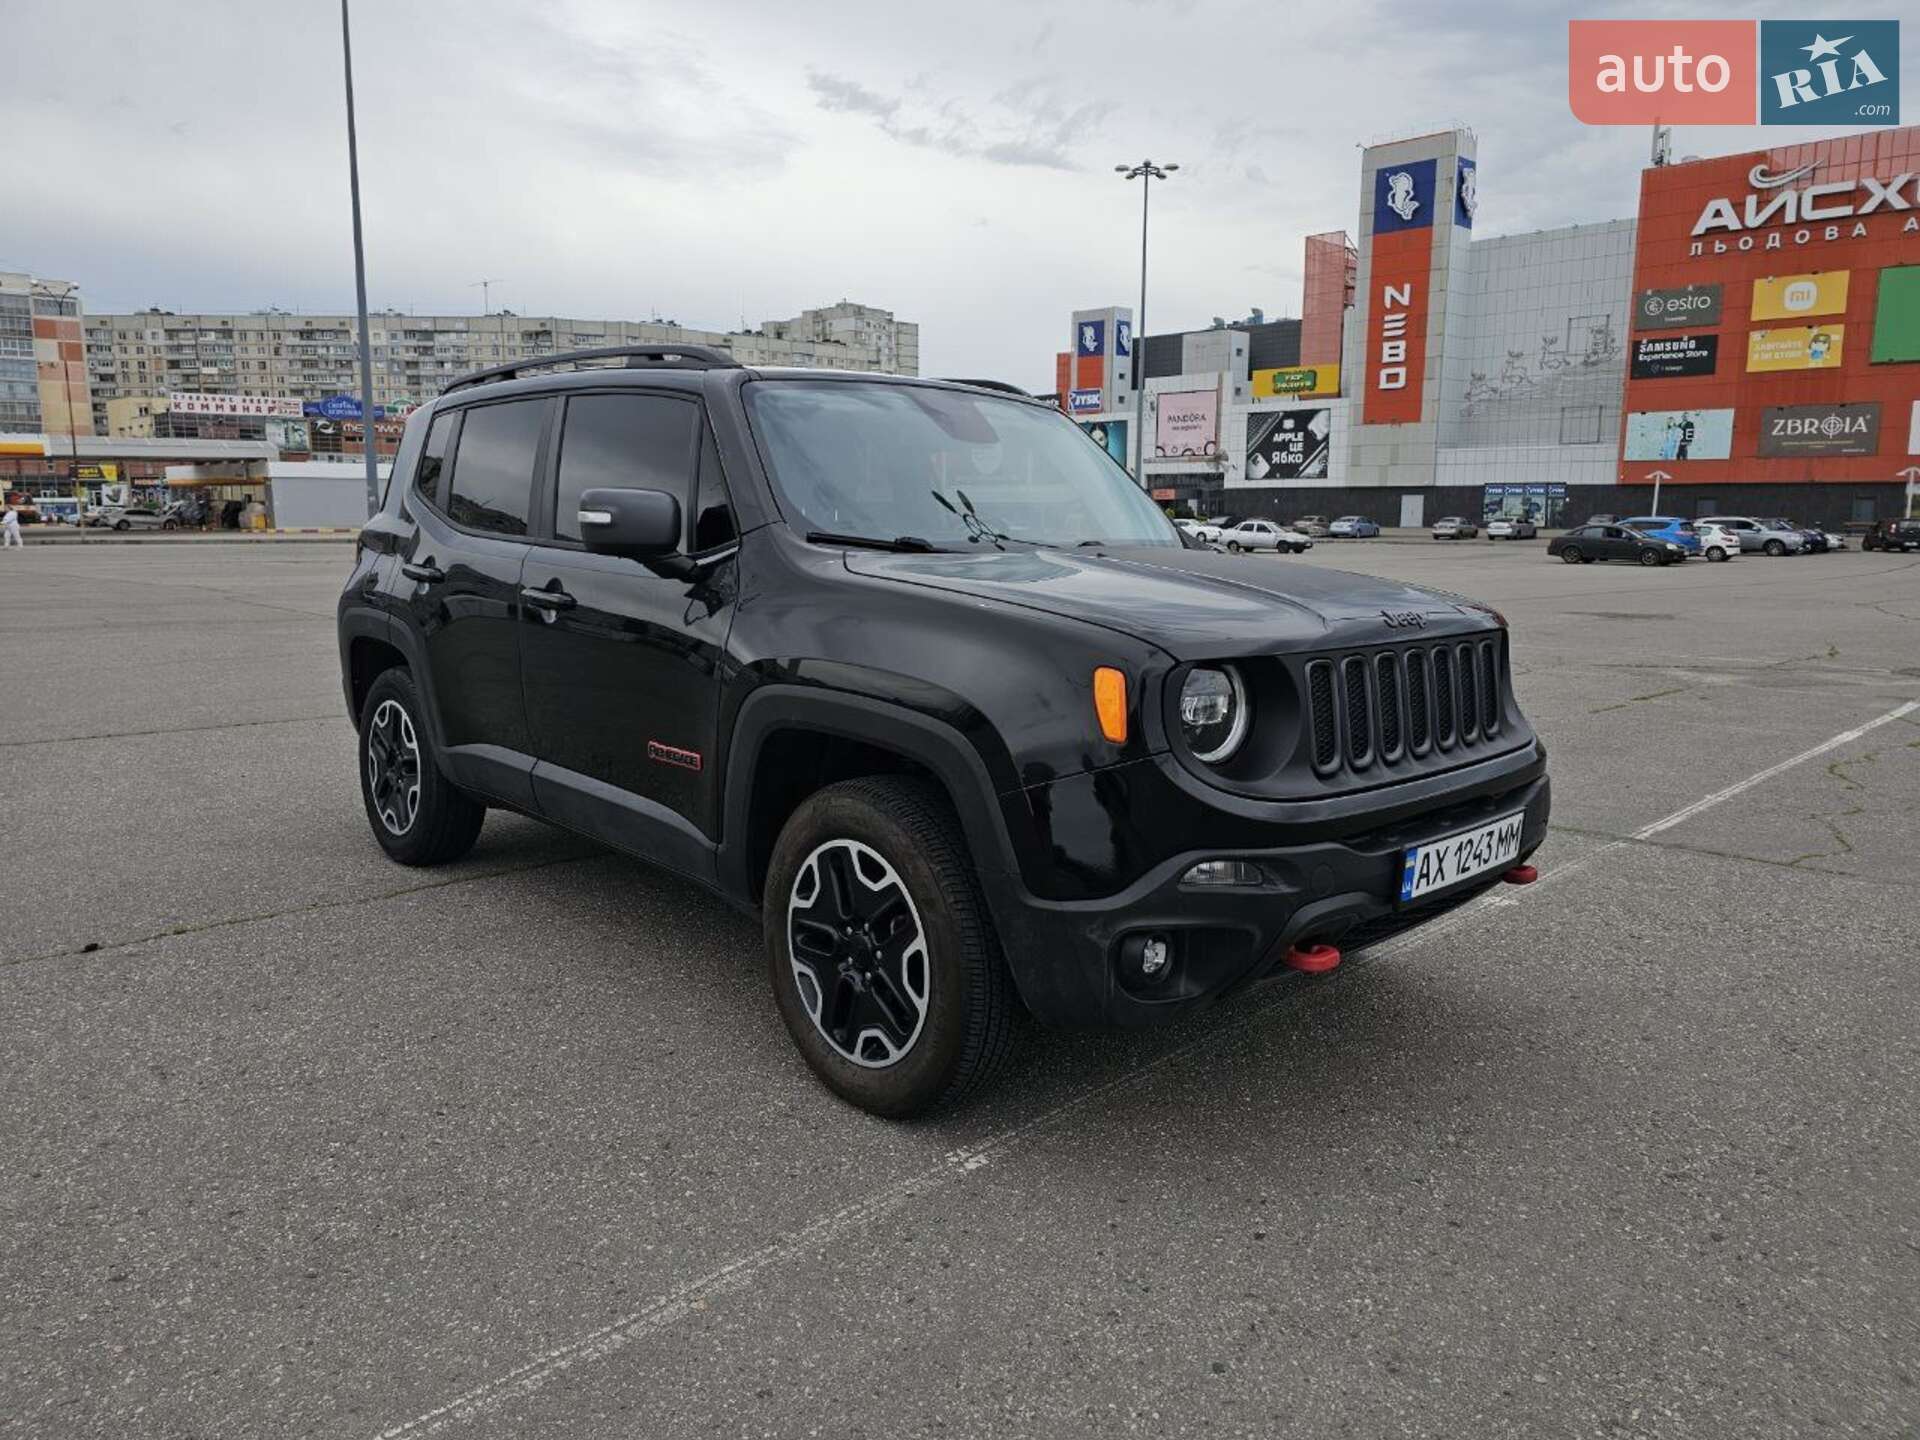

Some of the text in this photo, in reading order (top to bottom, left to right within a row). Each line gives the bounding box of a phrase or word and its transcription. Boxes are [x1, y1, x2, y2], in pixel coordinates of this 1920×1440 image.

[1690, 160, 1920, 237] АЙСХ
[1689, 222, 1867, 256] ЛЬОДОВА
[1666, 295, 1711, 311] estro
[1379, 283, 1411, 389] NEBO
[1639, 340, 1696, 353] SAMSUNG
[1638, 350, 1708, 361] Experience Store
[1075, 394, 1100, 405] JYSK
[1168, 413, 1207, 424] PANDORA
[1272, 432, 1304, 442] APPLE
[1289, 442, 1304, 453] ЦЕ
[1380, 610, 1427, 629] Jeep
[1415, 820, 1521, 889] AX 1243 MM
